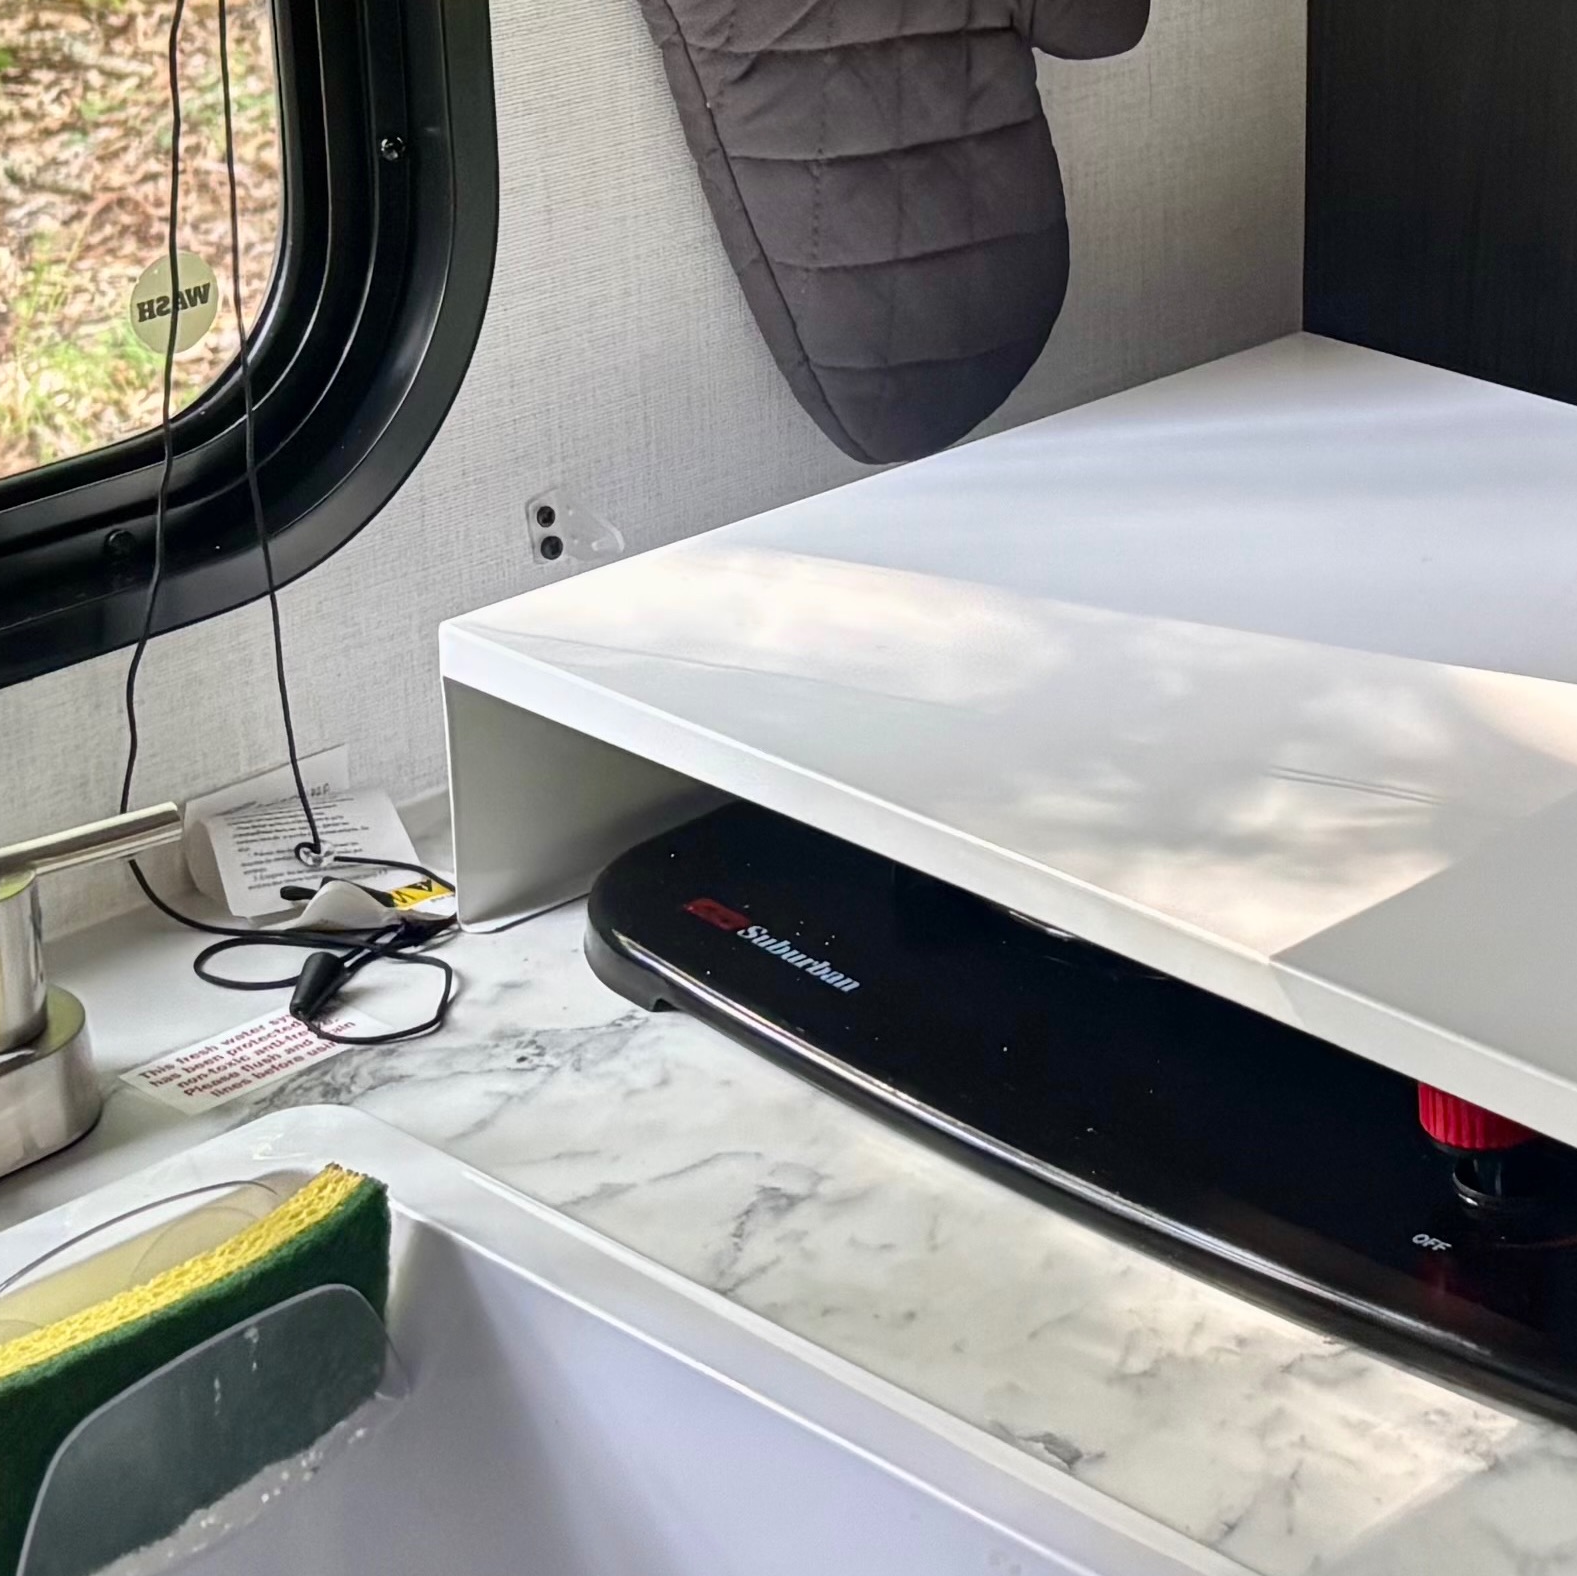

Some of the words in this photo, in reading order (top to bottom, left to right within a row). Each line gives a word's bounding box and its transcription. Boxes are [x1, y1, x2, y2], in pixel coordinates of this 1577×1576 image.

[736, 925, 860, 993] Suburban
[137, 1064, 175, 1079] This
[176, 1045, 219, 1064] fresh
[307, 1041, 337, 1057] usin
[183, 1071, 241, 1097] Please
[1411, 1233, 1452, 1253] OFF
